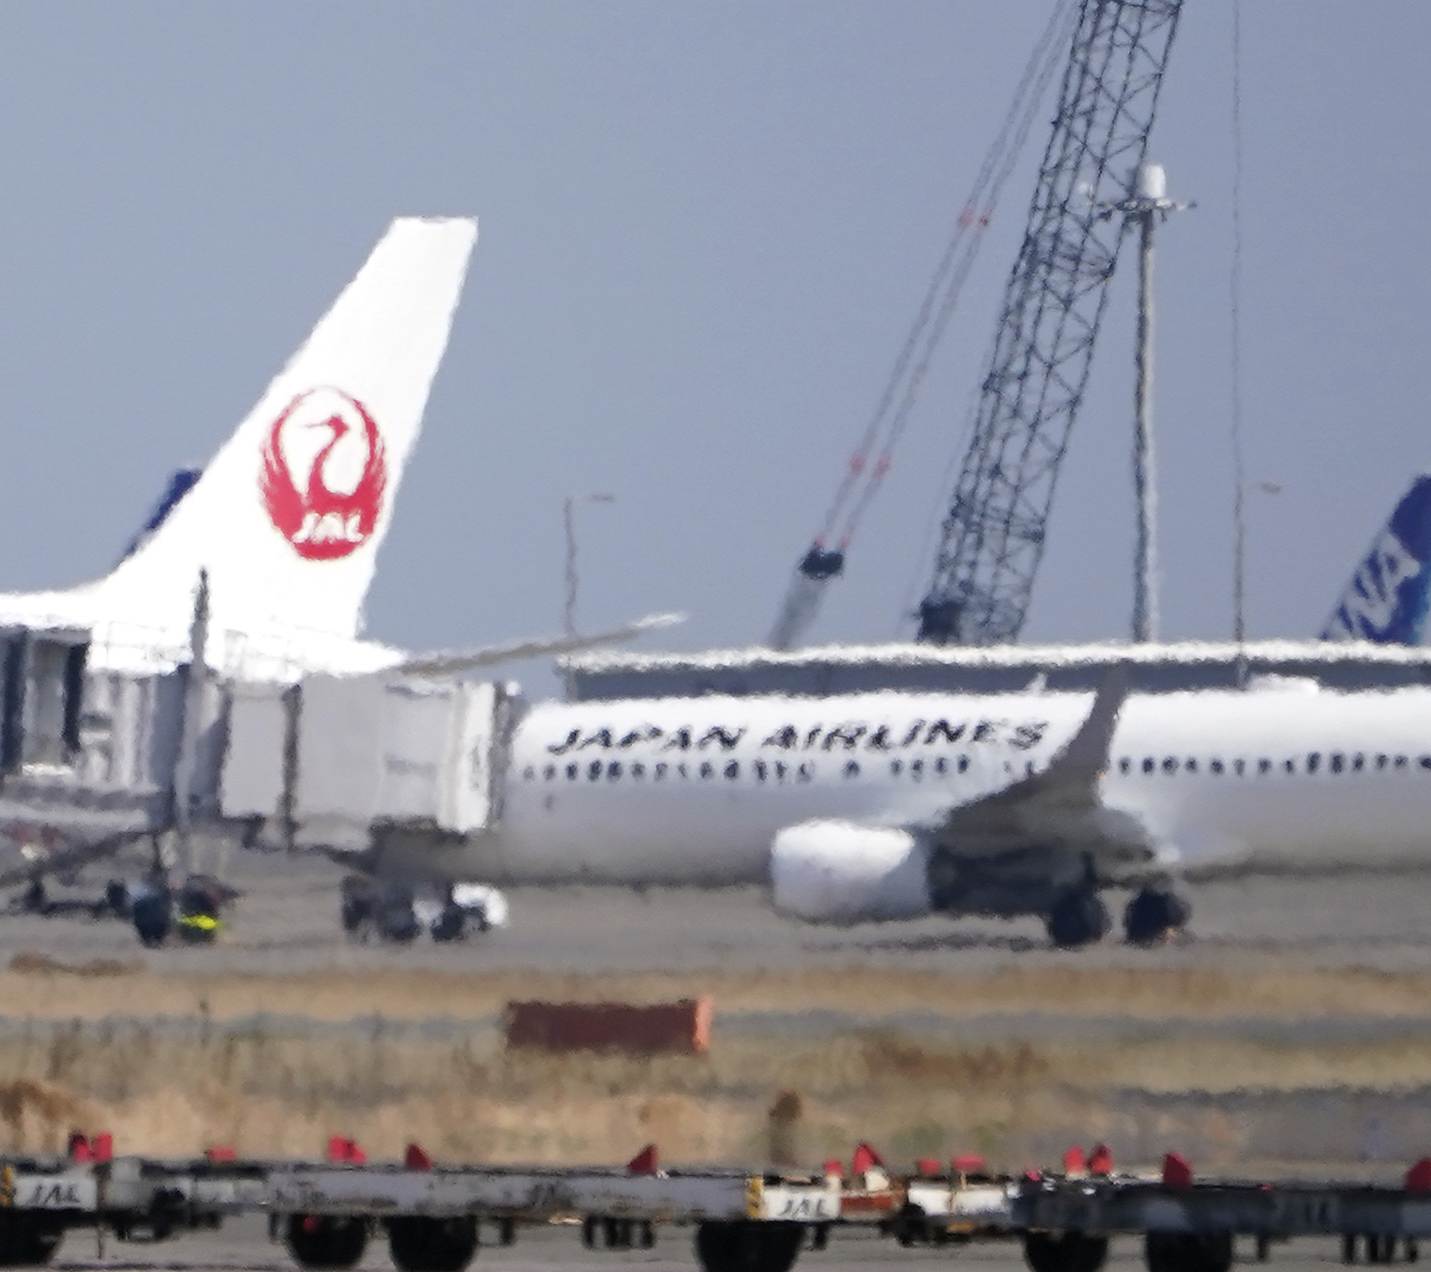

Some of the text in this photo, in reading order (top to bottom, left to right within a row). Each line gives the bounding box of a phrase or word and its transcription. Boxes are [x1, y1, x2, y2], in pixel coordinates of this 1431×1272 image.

[291, 512, 364, 545] JAL
[547, 717, 1049, 756] JAPAN AIRLINES
[777, 1198, 830, 1218] JAL
